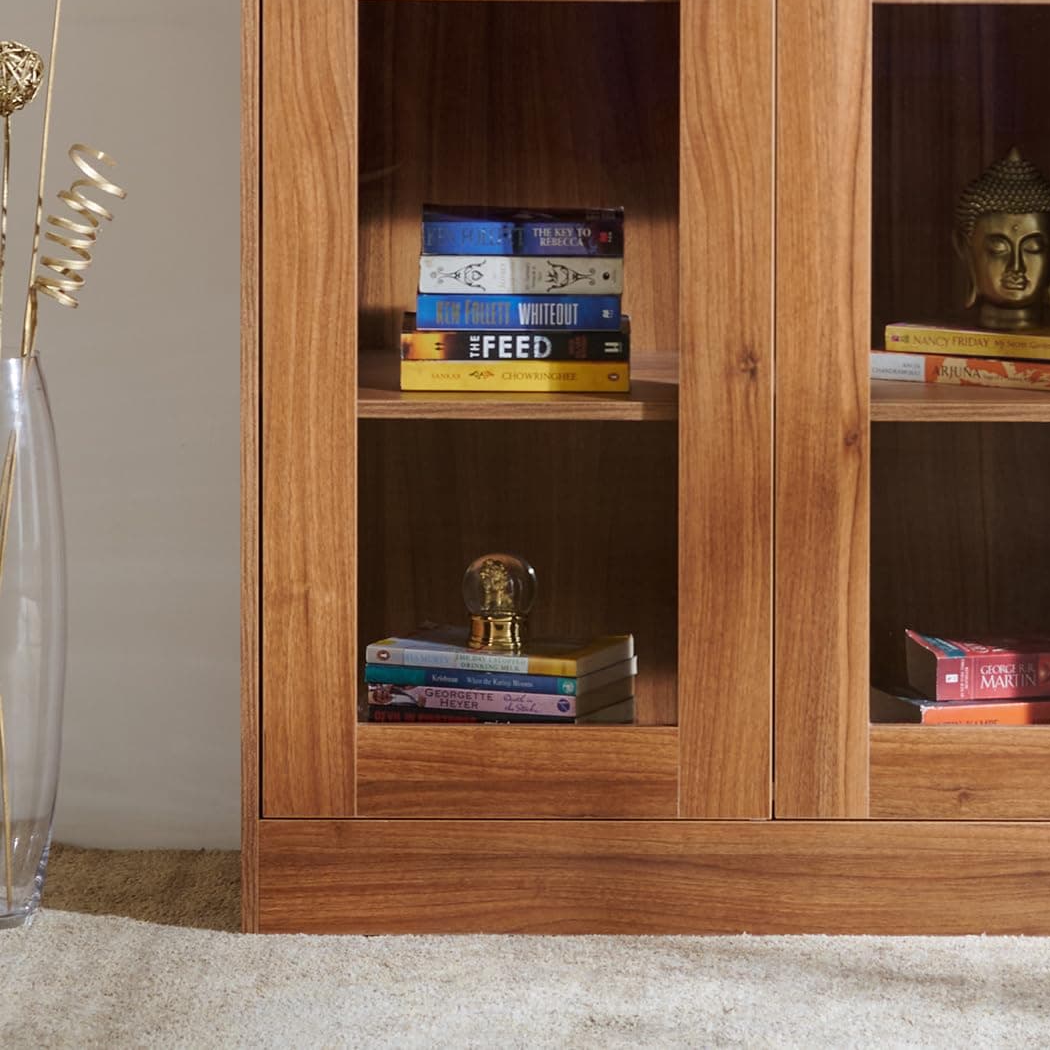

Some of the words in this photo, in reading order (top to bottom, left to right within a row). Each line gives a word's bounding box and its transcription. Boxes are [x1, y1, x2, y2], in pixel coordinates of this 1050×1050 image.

[533, 227, 553, 237] THE
[554, 228, 574, 237] KEY
[575, 228, 592, 238] TO
[539, 237, 584, 248] REBECCA
[464, 299, 511, 326] FOLLETT
[518, 302, 579, 326] WHITEOUT
[469, 335, 481, 358] THE
[482, 335, 552, 359] FEED
[912, 335, 950, 348] NANCY
[952, 337, 989, 348] FRIDAY
[501, 370, 577, 381] CHOWRINGHEE
[931, 365, 981, 381] ARJUNA
[980, 663, 1017, 676] GEORGE
[980, 674, 1037, 690] MARTIN
[424, 688, 494, 703] GEORGETTE
[439, 699, 479, 711] HEYER
